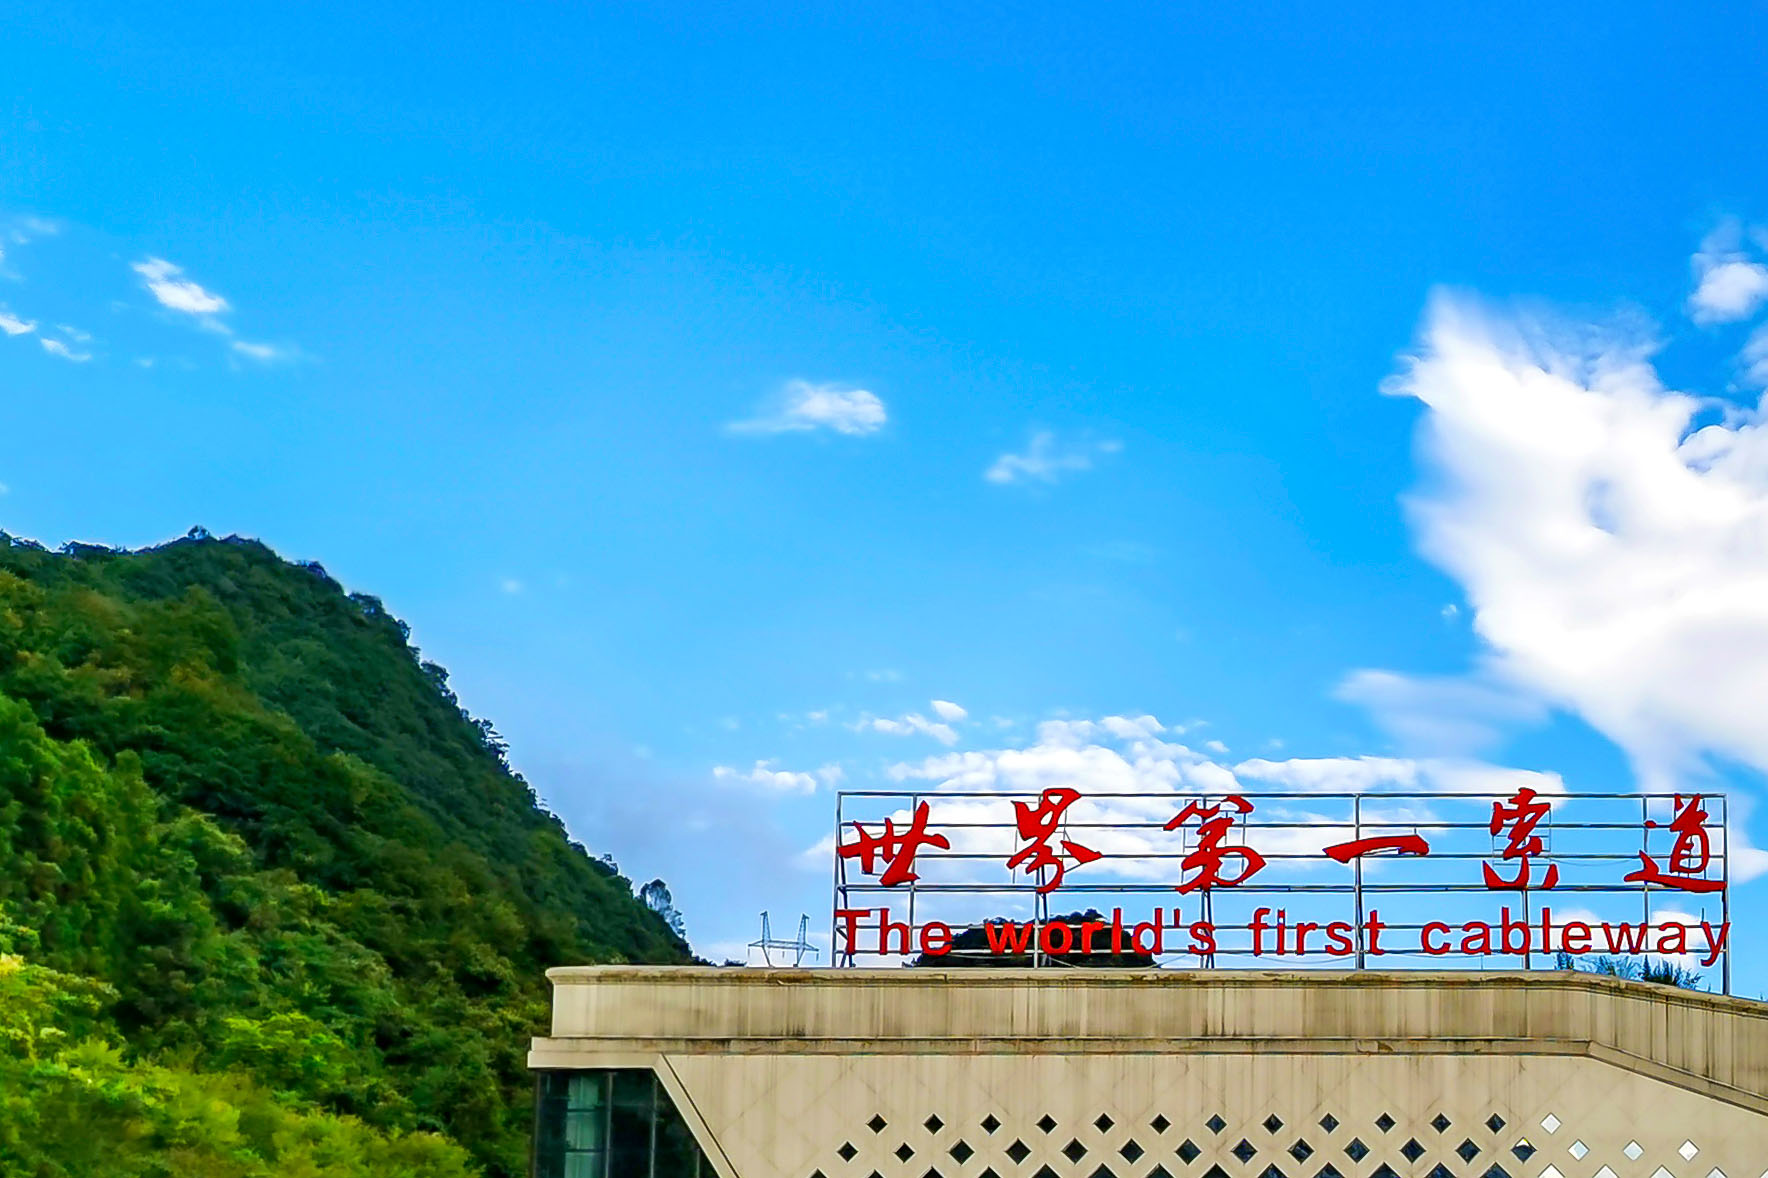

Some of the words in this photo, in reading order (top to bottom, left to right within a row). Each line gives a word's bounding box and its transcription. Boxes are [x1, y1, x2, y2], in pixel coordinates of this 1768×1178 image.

[838, 787, 1728, 895] 世界第一索道
[835, 907, 954, 956] The
[985, 906, 1215, 957] world's
[1247, 907, 1385, 956] first
[1421, 906, 1731, 967] cableway
